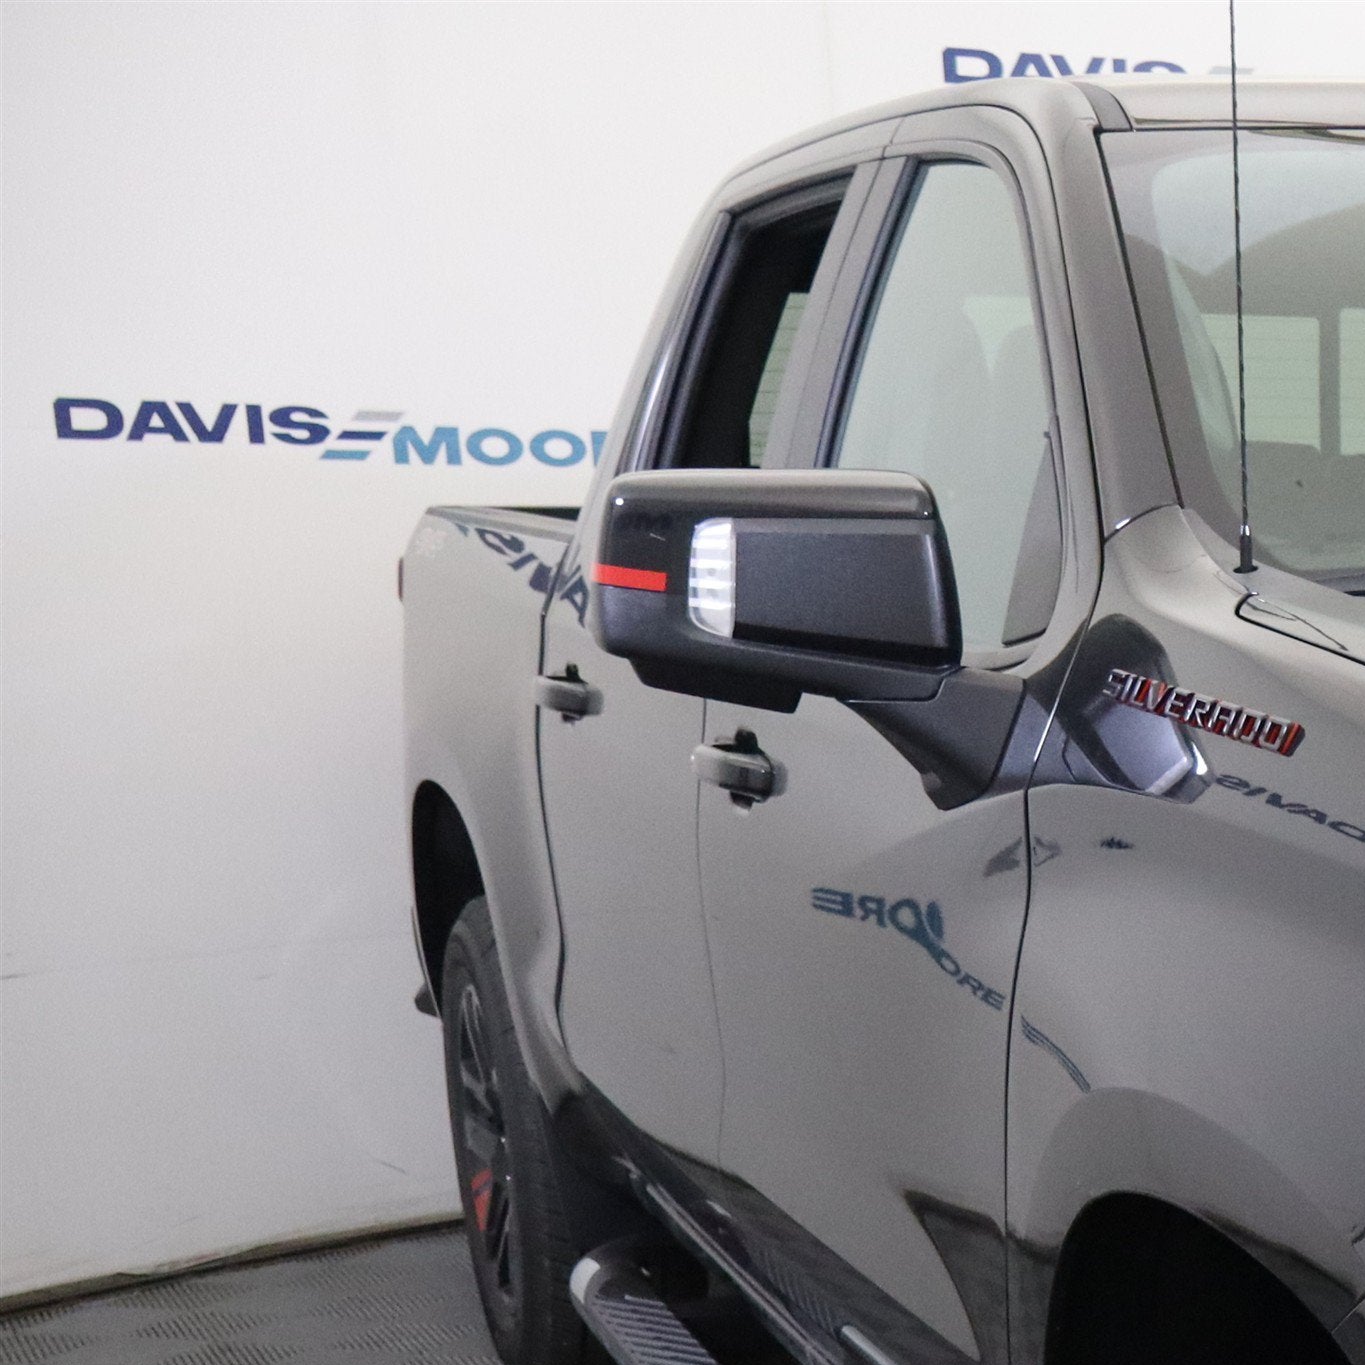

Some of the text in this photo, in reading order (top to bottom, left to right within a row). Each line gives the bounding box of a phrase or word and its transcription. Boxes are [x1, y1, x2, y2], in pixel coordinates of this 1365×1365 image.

[52, 396, 608, 468] DAVIS MOO
[1102, 668, 1304, 757] SILVERADO
